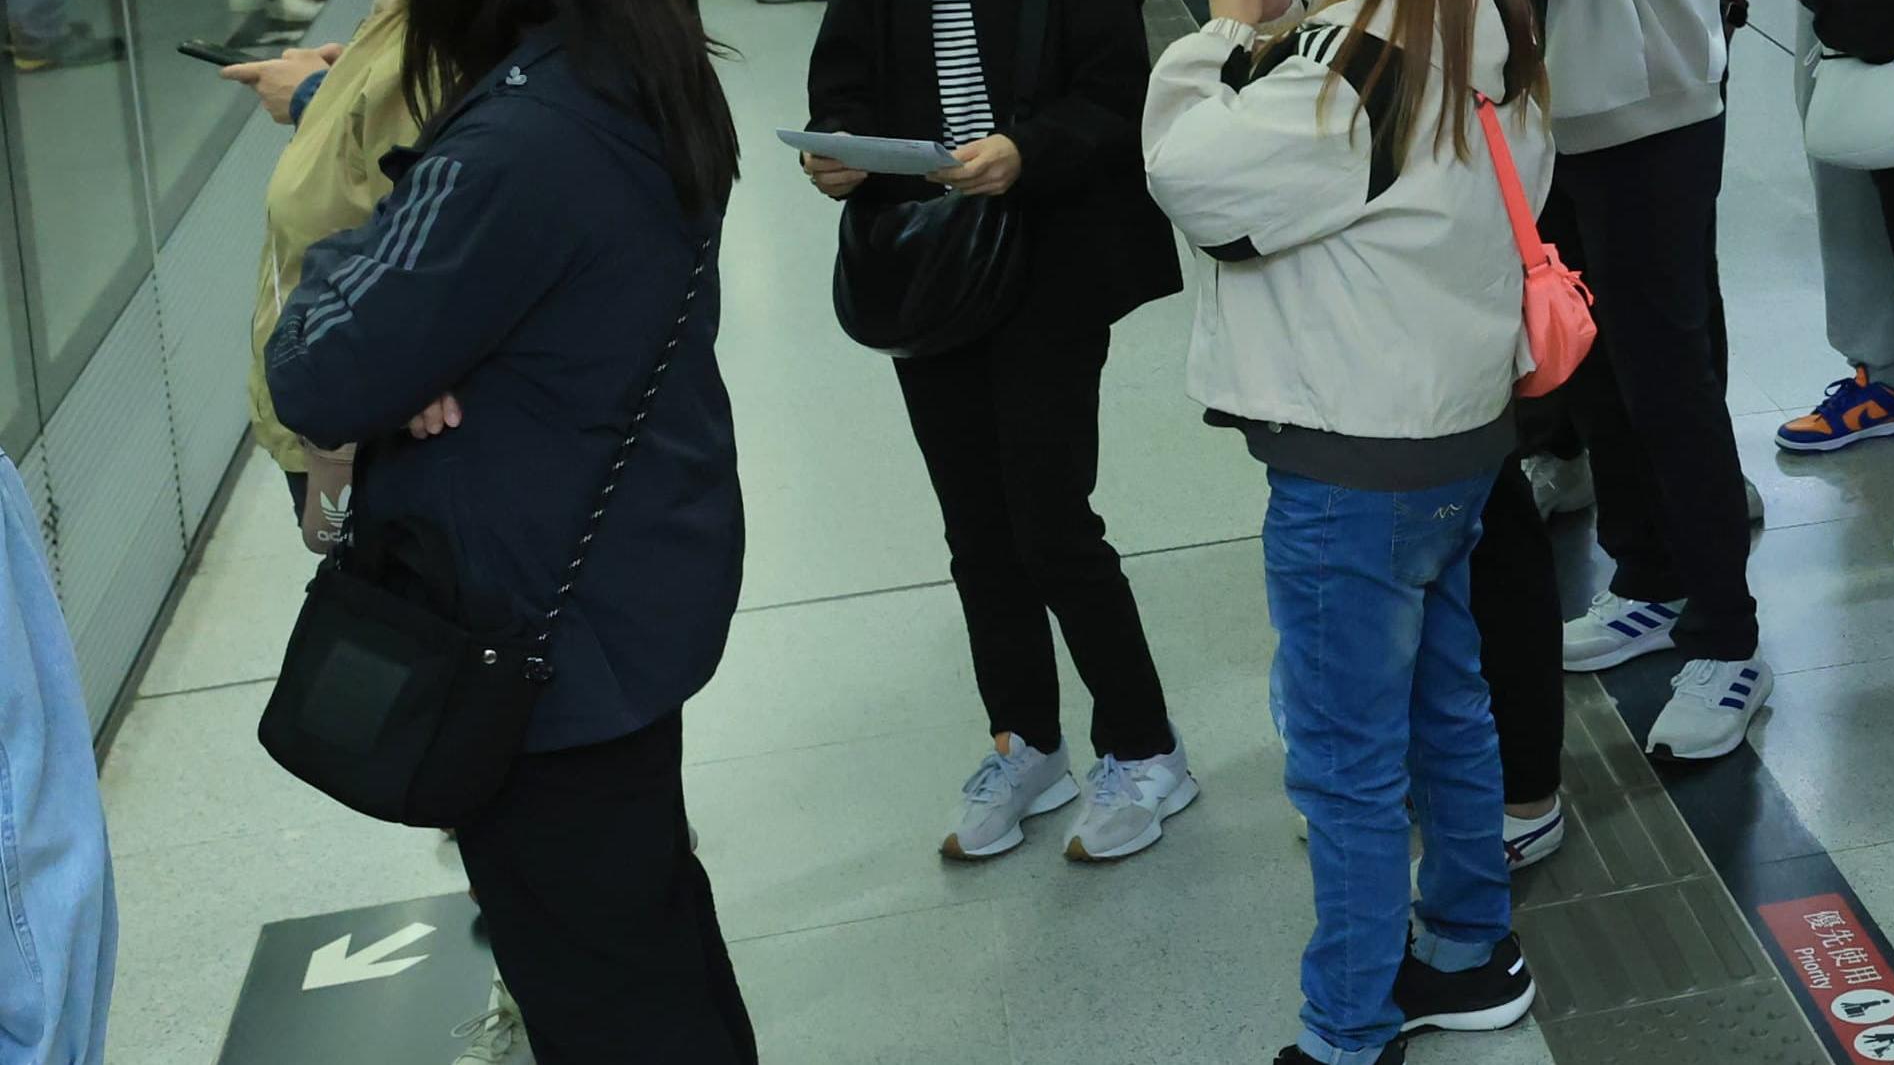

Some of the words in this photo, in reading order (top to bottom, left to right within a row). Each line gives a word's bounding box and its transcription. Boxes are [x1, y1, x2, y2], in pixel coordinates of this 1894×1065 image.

[1794, 946, 1832, 989] Priority
[1804, 910, 1882, 984] 優先使用
